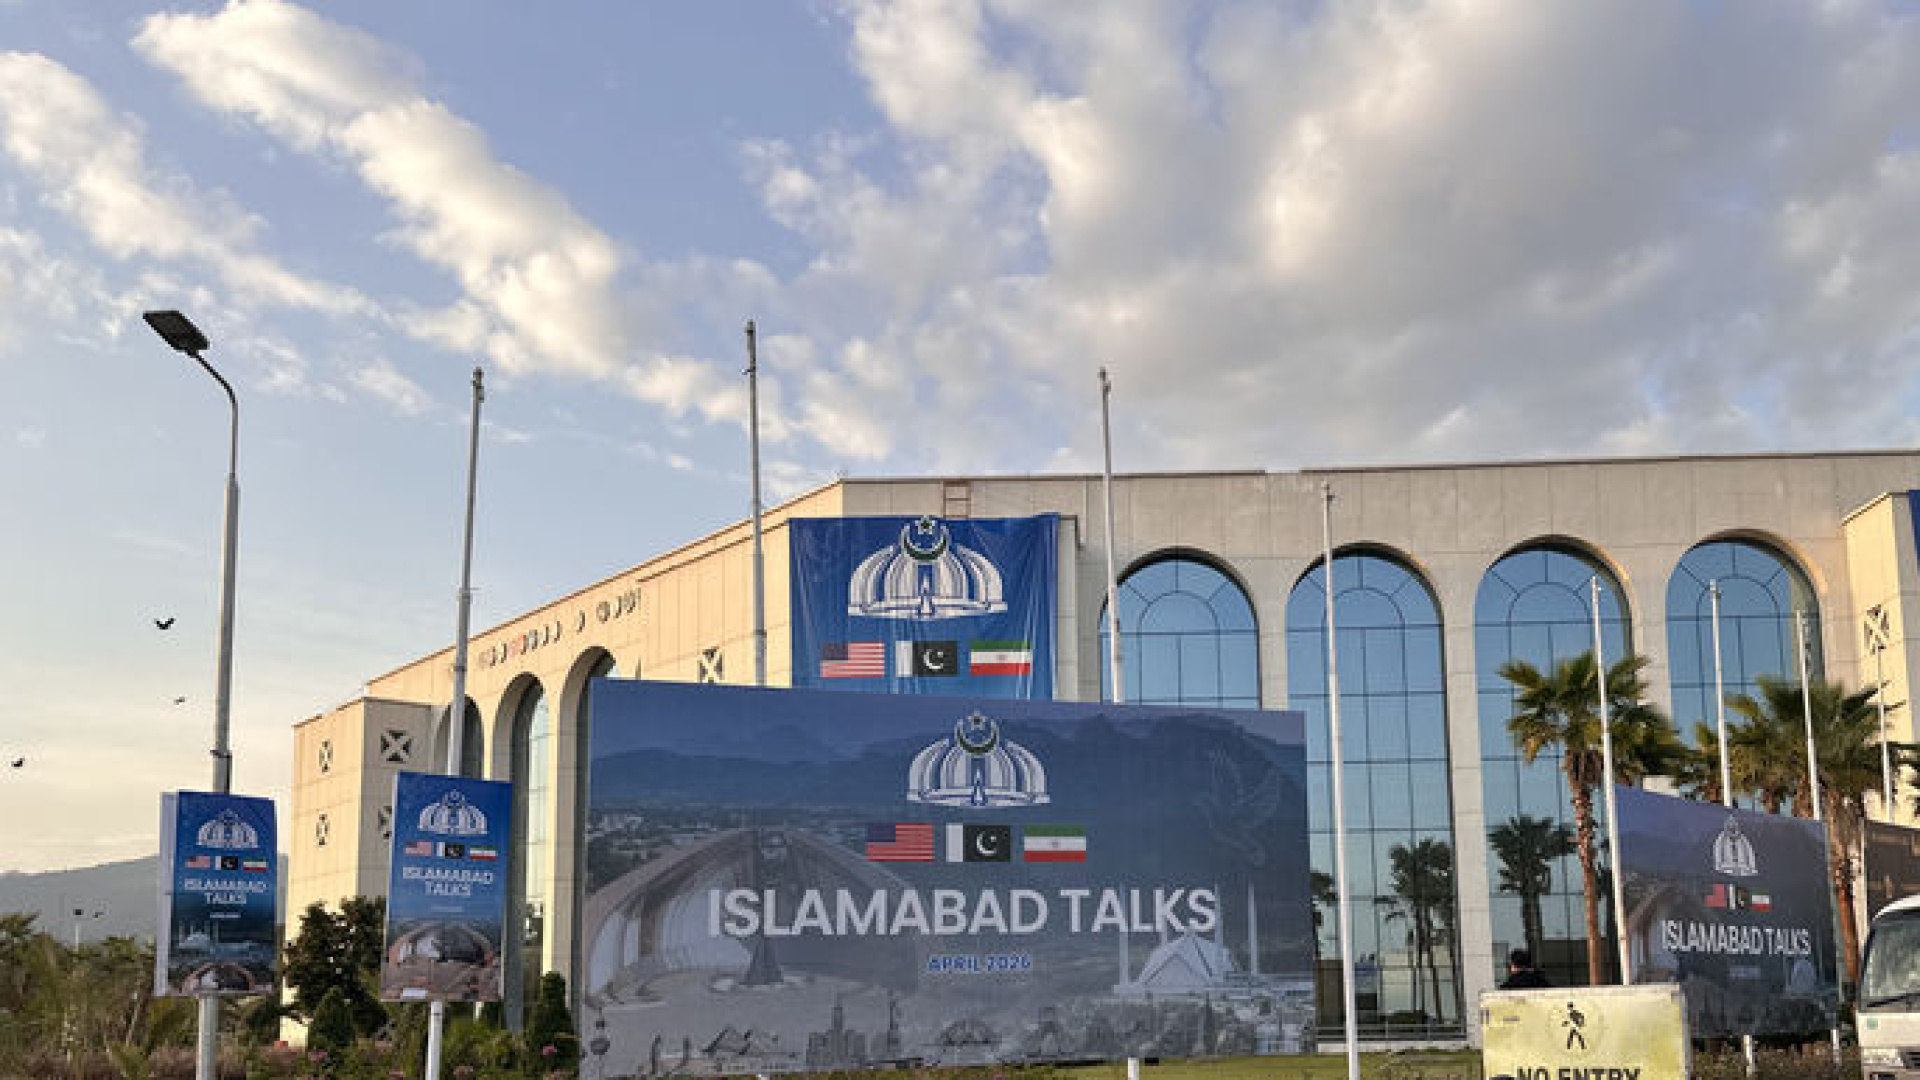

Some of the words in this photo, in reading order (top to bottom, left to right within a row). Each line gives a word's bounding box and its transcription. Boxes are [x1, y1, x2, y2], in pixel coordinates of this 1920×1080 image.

[709, 888, 1048, 937] ISLAMABAD
[1060, 888, 1217, 933] TALKS
[1661, 919, 1763, 954] ISLAMABAD
[1765, 928, 1811, 956] TALKS
[927, 954, 980, 973] APRIL
[985, 953, 1031, 971] 2026
